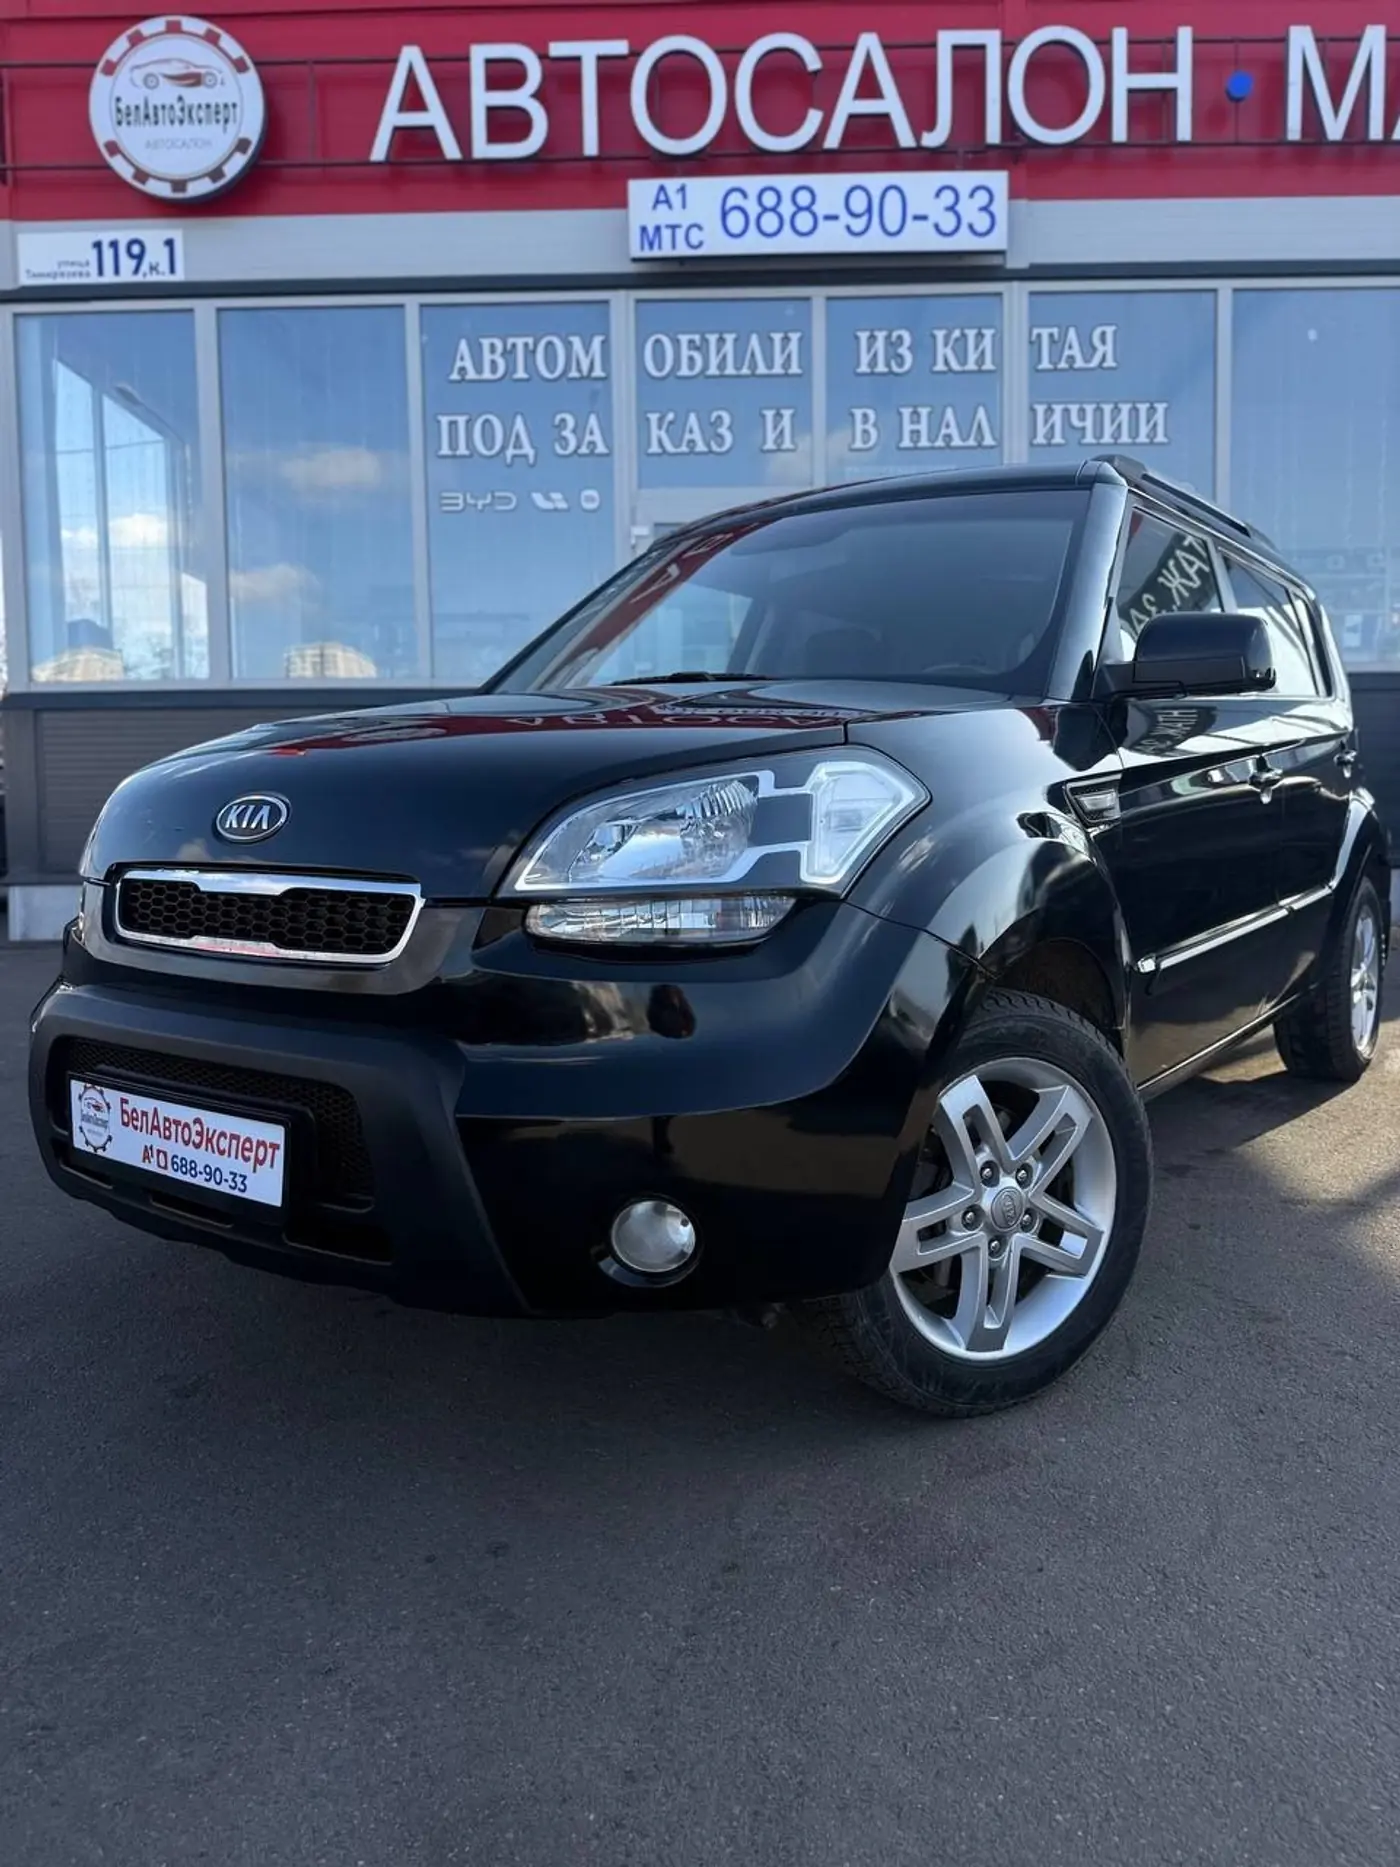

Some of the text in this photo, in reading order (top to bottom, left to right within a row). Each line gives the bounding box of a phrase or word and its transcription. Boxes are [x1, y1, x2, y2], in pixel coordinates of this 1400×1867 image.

[115, 94, 238, 134] БелАвтоЭксперт
[369, 23, 1400, 163] АВТОСАЛОН М
[651, 182, 687, 211] A1
[719, 184, 997, 240] 688-90-33
[640, 222, 705, 251] МТС
[855, 328, 914, 374] ИЗ
[436, 413, 537, 467] ПОД
[760, 407, 796, 452] И
[850, 407, 878, 451] В
[224, 804, 271, 830] KIA
[119, 1097, 281, 1173] БелАвтоЭксперт
[170, 1154, 248, 1193] 688-90-33
